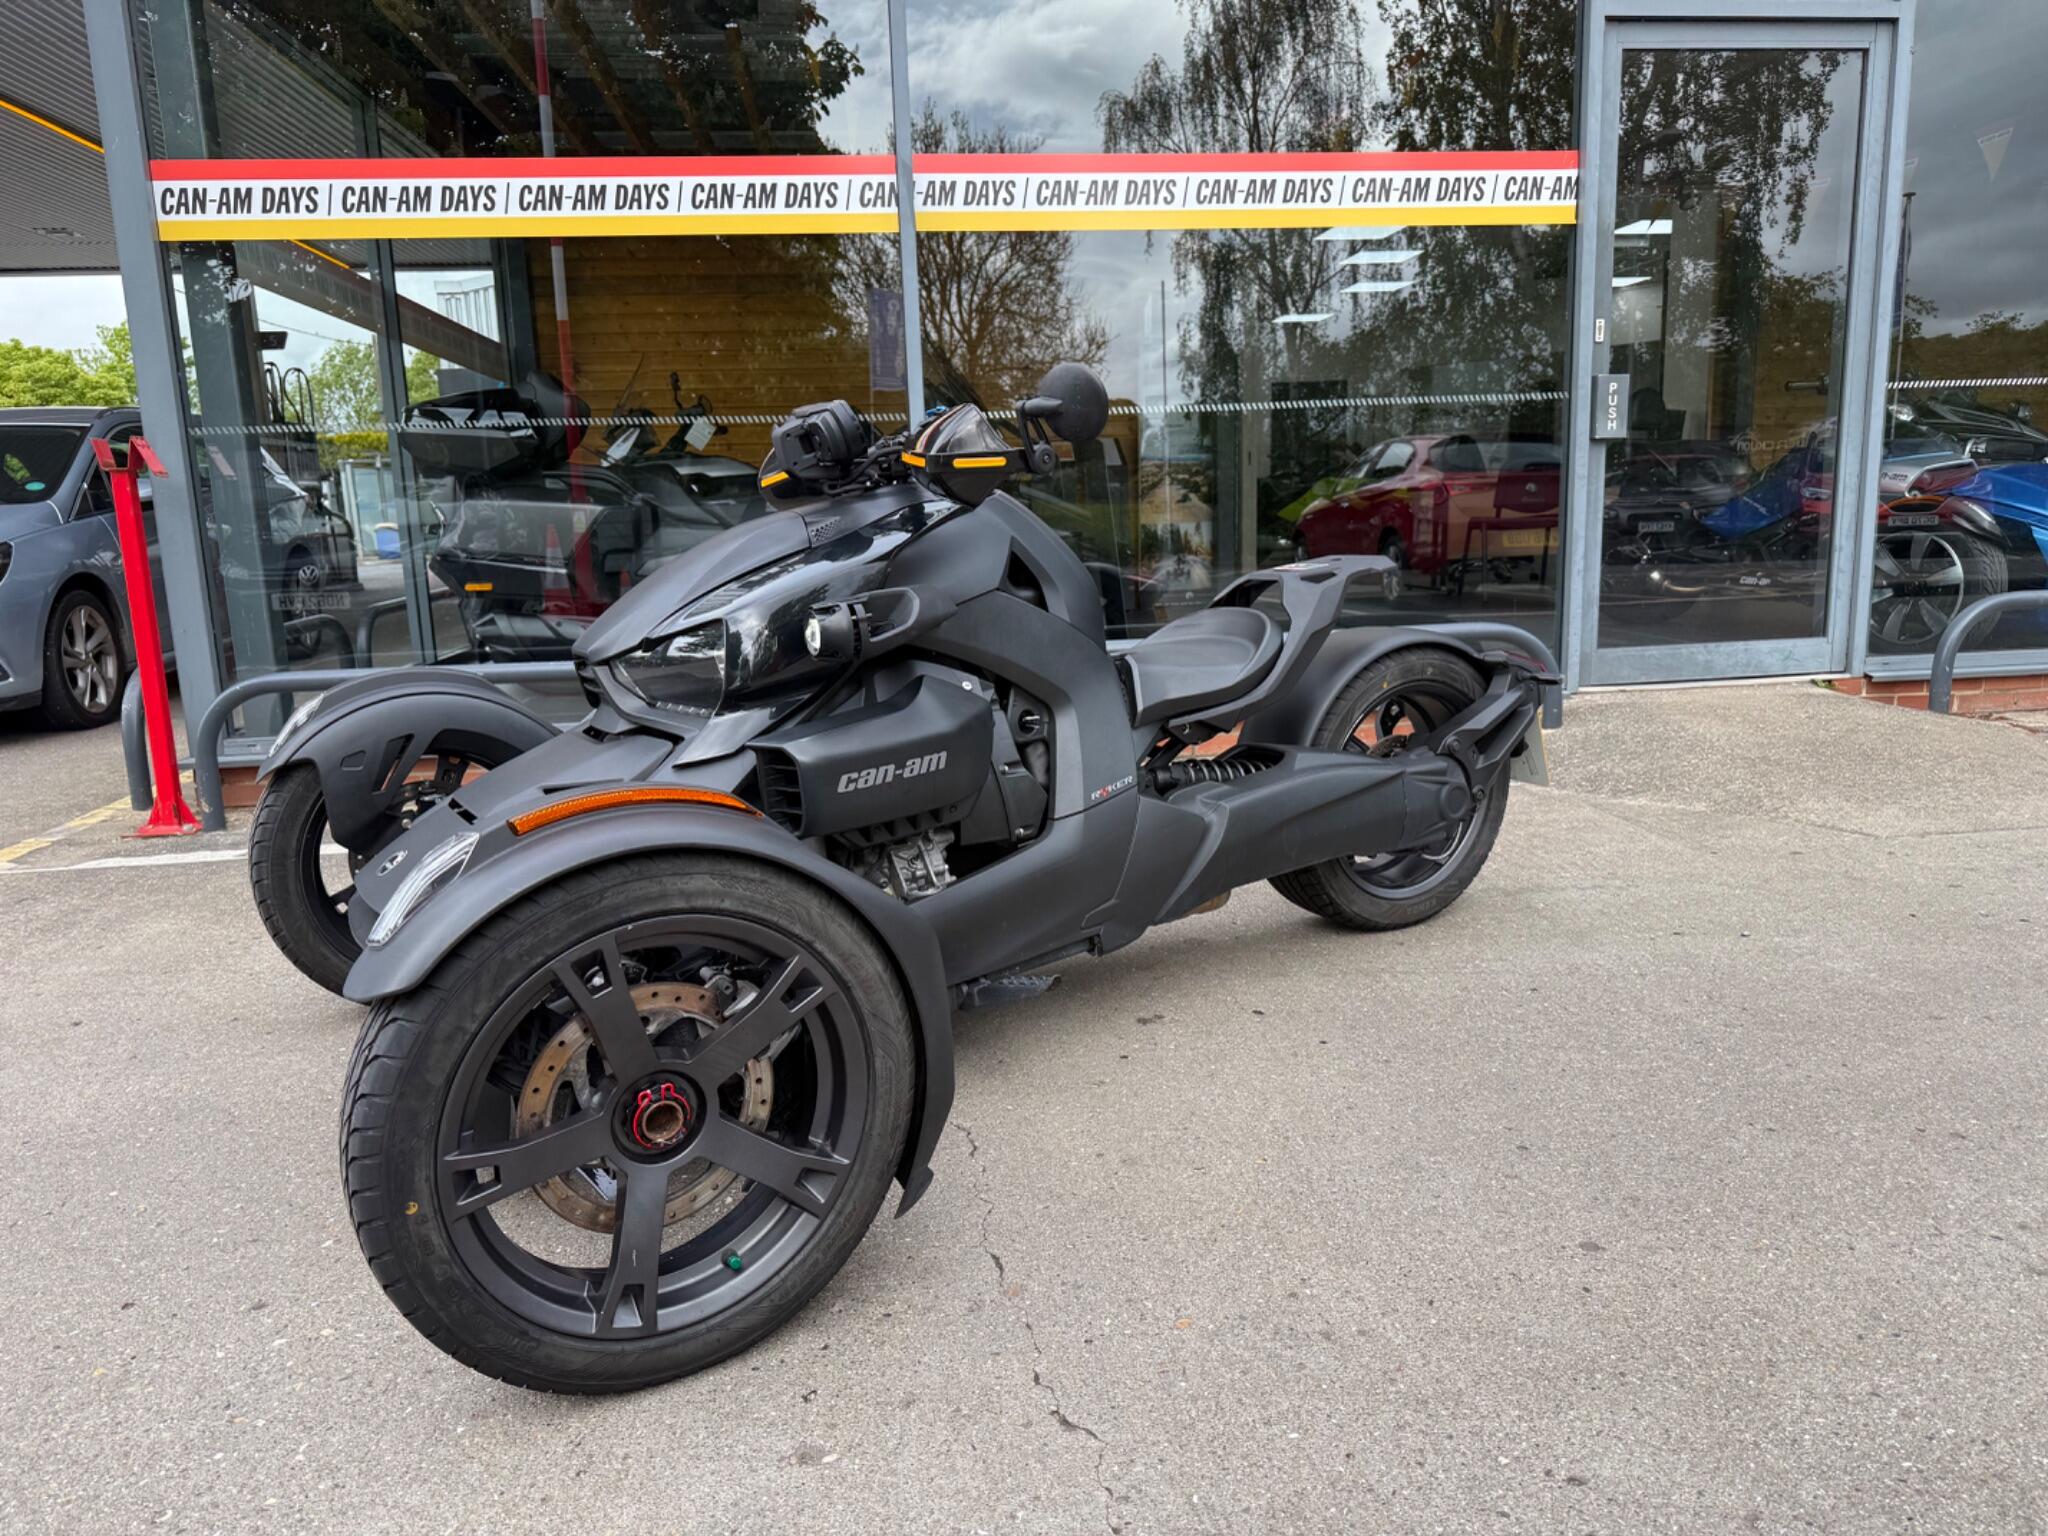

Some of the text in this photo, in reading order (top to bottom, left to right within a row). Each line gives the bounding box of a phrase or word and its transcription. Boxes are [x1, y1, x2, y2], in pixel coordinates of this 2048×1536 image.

[160, 187, 251, 215] CAN-AM
[261, 186, 319, 214] DAYS
[341, 185, 432, 213] CAN-AM
[439, 184, 497, 212] DAYS
[518, 184, 607, 211] CAN-AM
[614, 183, 670, 210] DAYS
[690, 183, 777, 210] CAN-AM
[784, 182, 839, 209] DAYS
[963, 180, 1016, 206] DAYS
[1036, 180, 1117, 206] CAN-AM
[1124, 179, 1177, 205] DAYS
[1196, 178, 1277, 204] CAN-AM
[1282, 178, 1334, 204] DAYS
[1352, 177, 1431, 203] CAN-AM
[1436, 177, 1487, 202] DAYS
[1504, 176, 1579, 201] CAN-AM
[1606, 381, 1619, 431] PUSH
[836, 750, 948, 794] can-am
